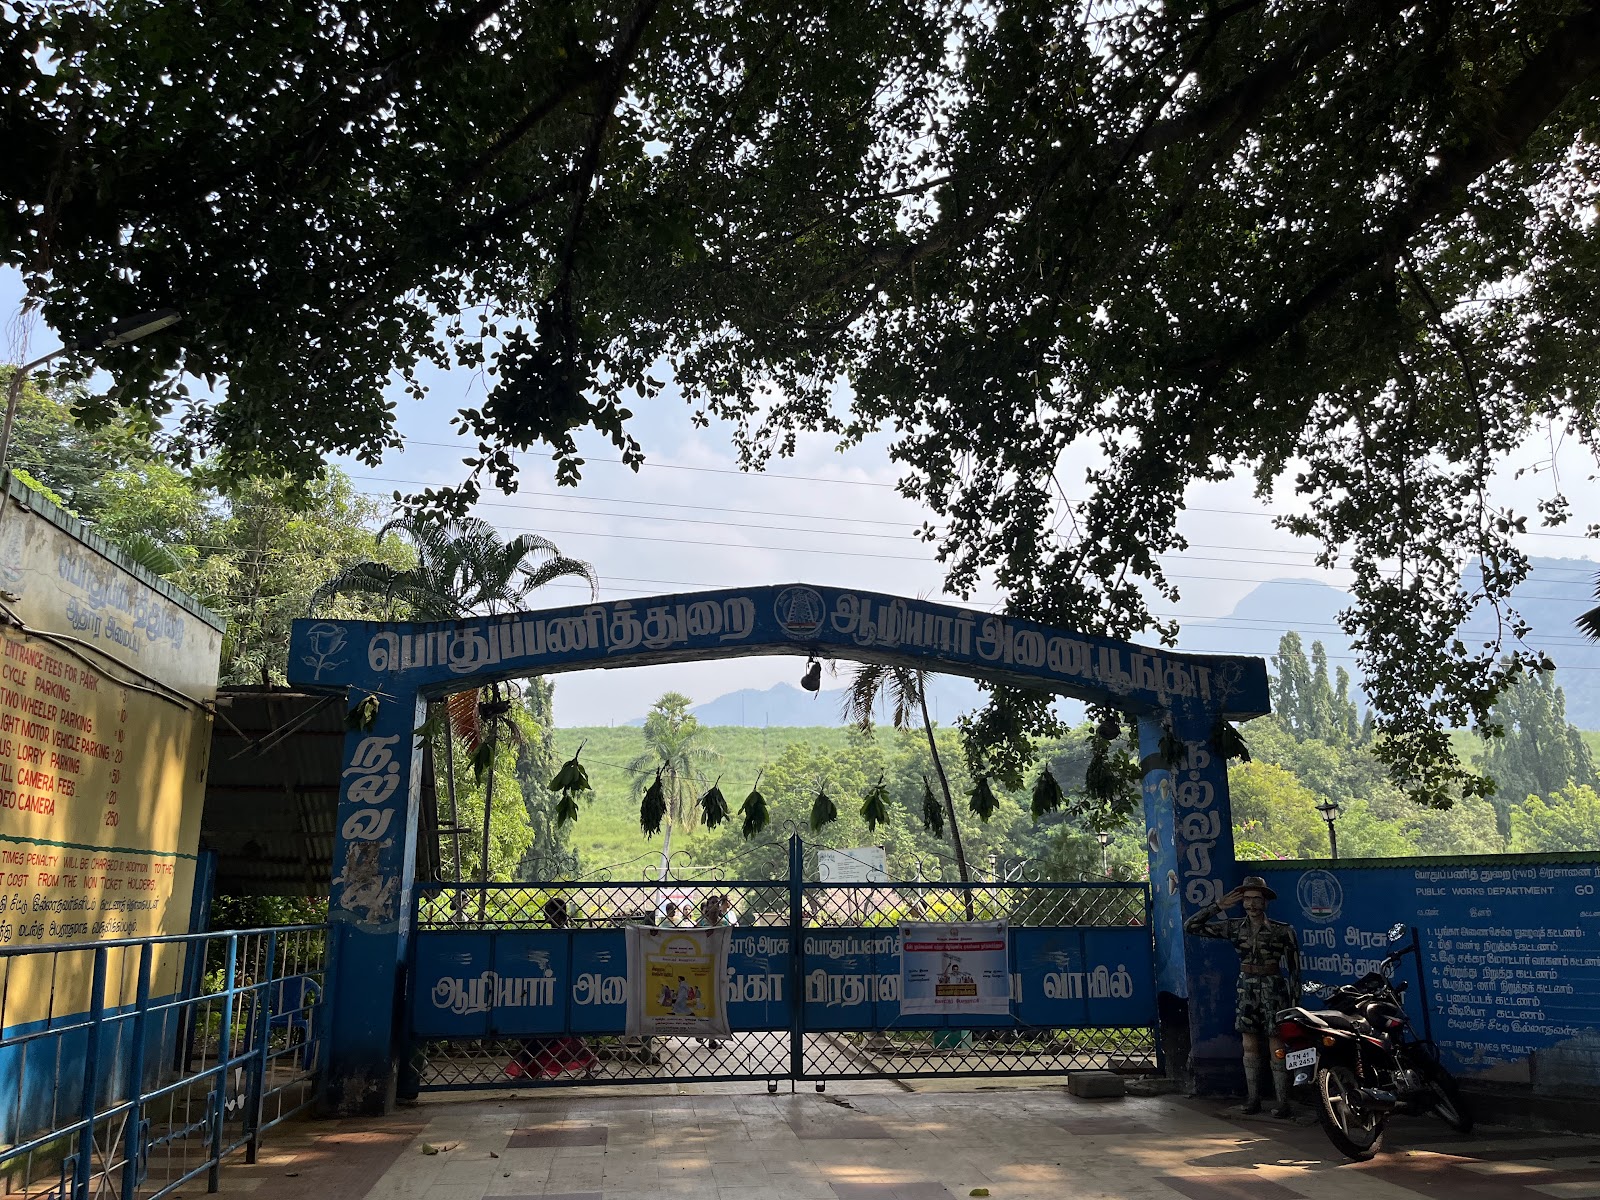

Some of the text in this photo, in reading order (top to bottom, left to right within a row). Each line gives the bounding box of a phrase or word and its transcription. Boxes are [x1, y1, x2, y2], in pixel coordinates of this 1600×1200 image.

[367, 596, 756, 673] பொதுப்பணித்துறை
[4, 639, 43, 671] ENTRANCE
[44, 655, 62, 678] FEES
[64, 664, 77, 683] FOR
[79, 671, 99, 693] PARK
[0, 686, 19, 709] TWO
[20, 694, 57, 722] WHEELER
[60, 711, 92, 734] PARKING
[2, 664, 128, 723] CYCLE PARKING 10
[0, 713, 123, 764] IGHT MOTOR VEHICLE PARKING 20
[16, 742, 46, 765] LORRY
[50, 752, 80, 774] PARKING
[111, 769, 120, 784] 50
[17, 767, 54, 792] CAMERA
[57, 777, 76, 797] FEES
[108, 790, 117, 805] 20
[18, 793, 55, 816] CAMERA
[105, 811, 119, 827] 250
[2, 850, 24, 865] TIMES
[26, 853, 59, 869] PENALTY
[63, 856, 79, 869] WILL
[79, 858, 89, 869] BE
[91, 857, 119, 871] CHARGED
[125, 861, 148, 873] ADDITION
[154, 863, 161, 873] TO
[1512, 868, 1537, 880] (PWD)
[6, 872, 29, 887] COST
[37, 872, 60, 887] FROM
[63, 874, 77, 888] THE
[83, 875, 98, 889] NON
[101, 876, 123, 890] TICKET
[1416, 884, 1594, 896] PUBLIC WORKS DEPARTMENT GO
[757, 935, 790, 957] அரசு
[1344, 926, 1388, 950] அரசு
[432, 969, 557, 1016] ஆழியார்
[1043, 963, 1133, 999] வாயில்
[1455, 1040, 1473, 1050] FIVE
[1474, 1042, 1500, 1051] TIMES
[1500, 1044, 1538, 1055] PENALTY
